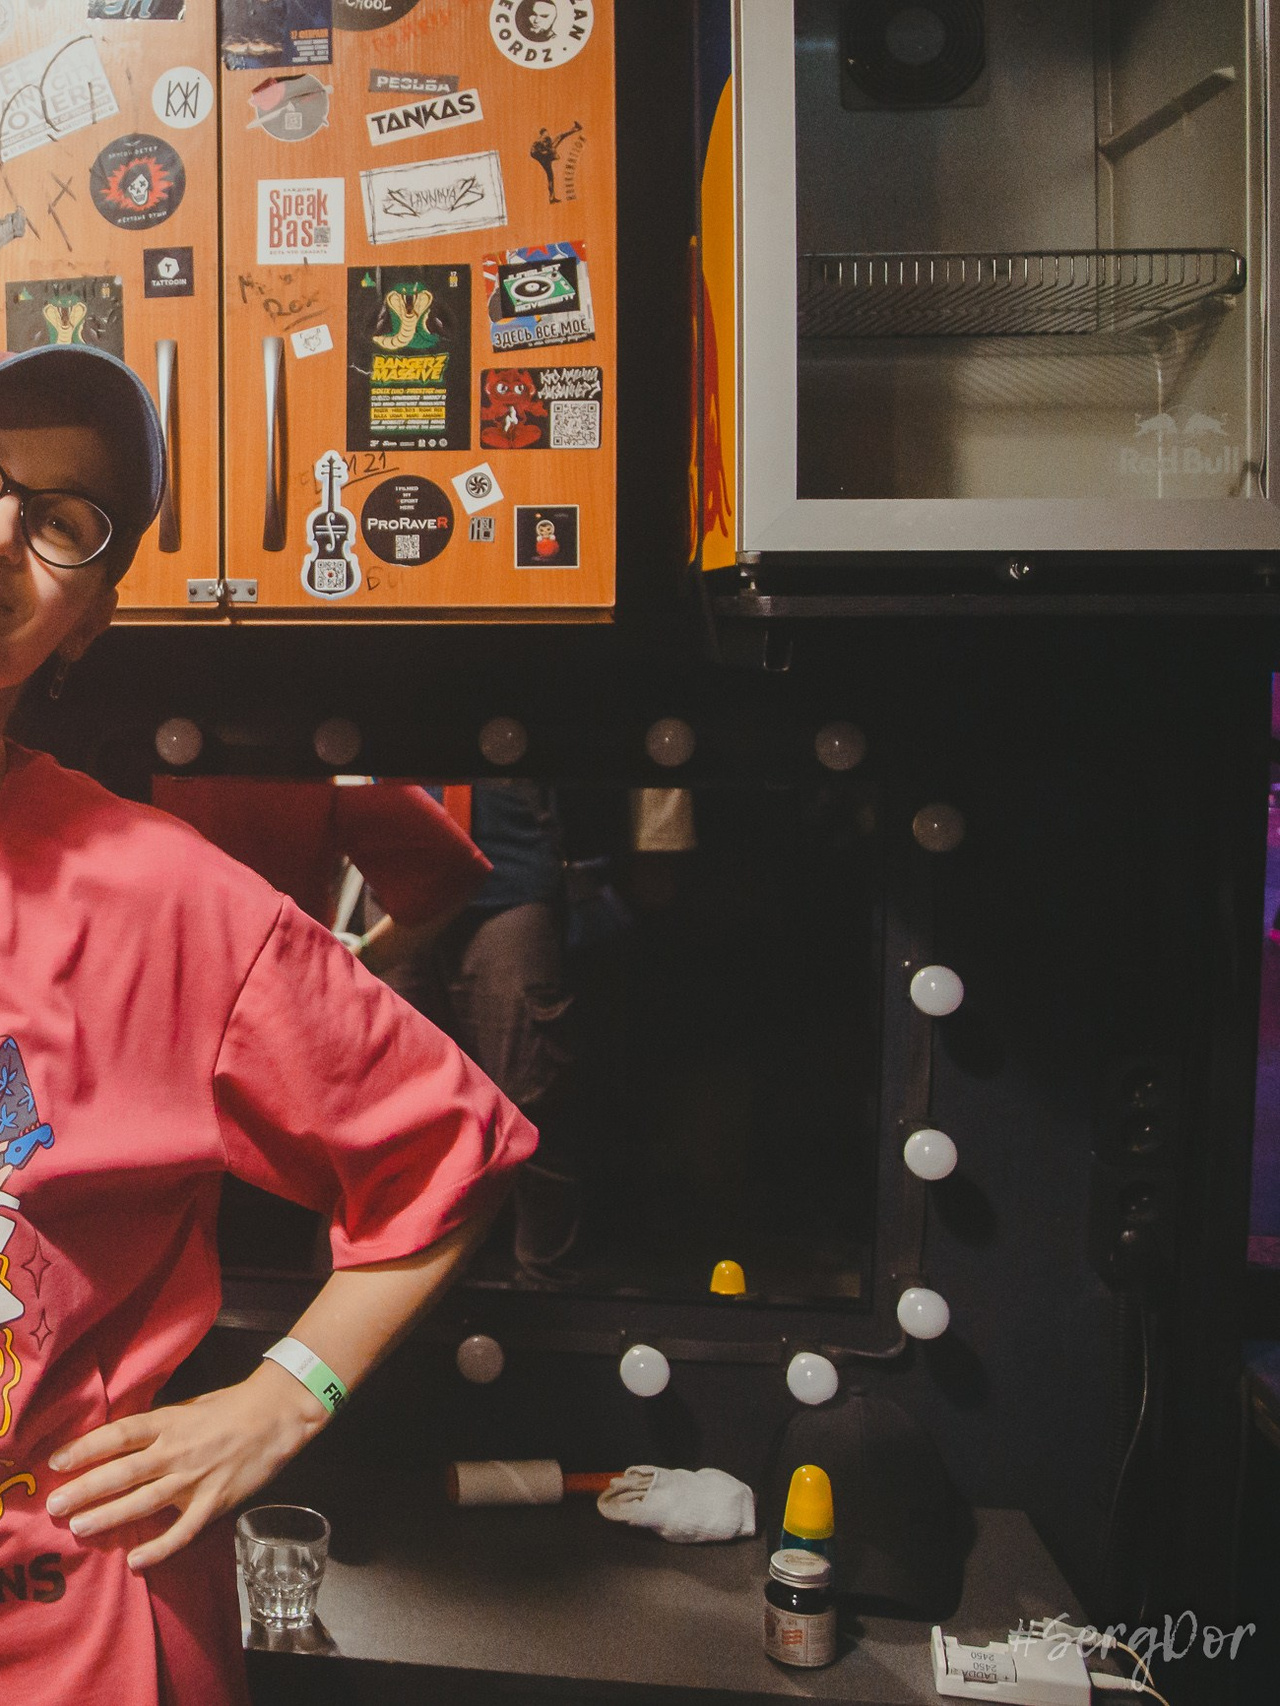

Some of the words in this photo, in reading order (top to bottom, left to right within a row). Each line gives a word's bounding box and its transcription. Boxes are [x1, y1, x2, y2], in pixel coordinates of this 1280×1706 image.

[371, 93, 476, 135] TANKAS
[494, 327, 532, 348] ЗДЕСЬ
[373, 355, 447, 369] BANGERZ
[371, 367, 442, 381] MASSIVE
[1182, 446, 1239, 474] Bull
[970, 1652, 995, 1662] 2450
[972, 1662, 998, 1673] 2450
[961, 1669, 998, 1681] LADDA
